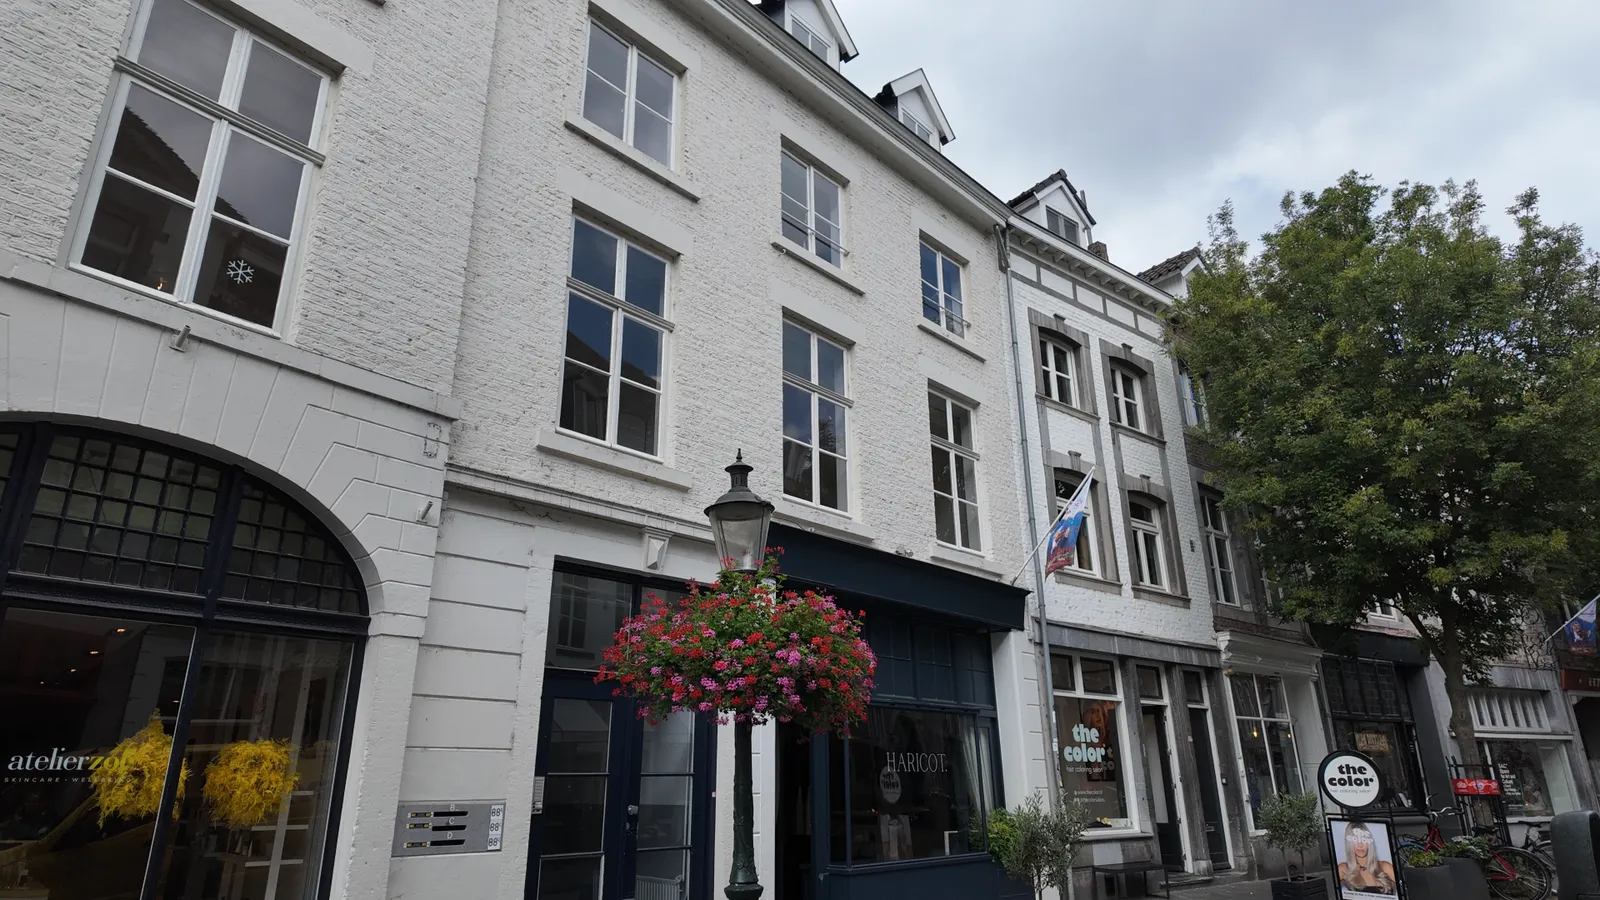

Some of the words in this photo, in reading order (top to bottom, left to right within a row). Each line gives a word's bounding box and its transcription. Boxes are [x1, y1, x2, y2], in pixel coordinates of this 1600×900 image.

[1071, 723, 1099, 743] the
[886, 752, 948, 773] HARICOT.
[1063, 743, 1106, 763] color
[1337, 763, 1367, 775] the
[1328, 776, 1374, 787] color
